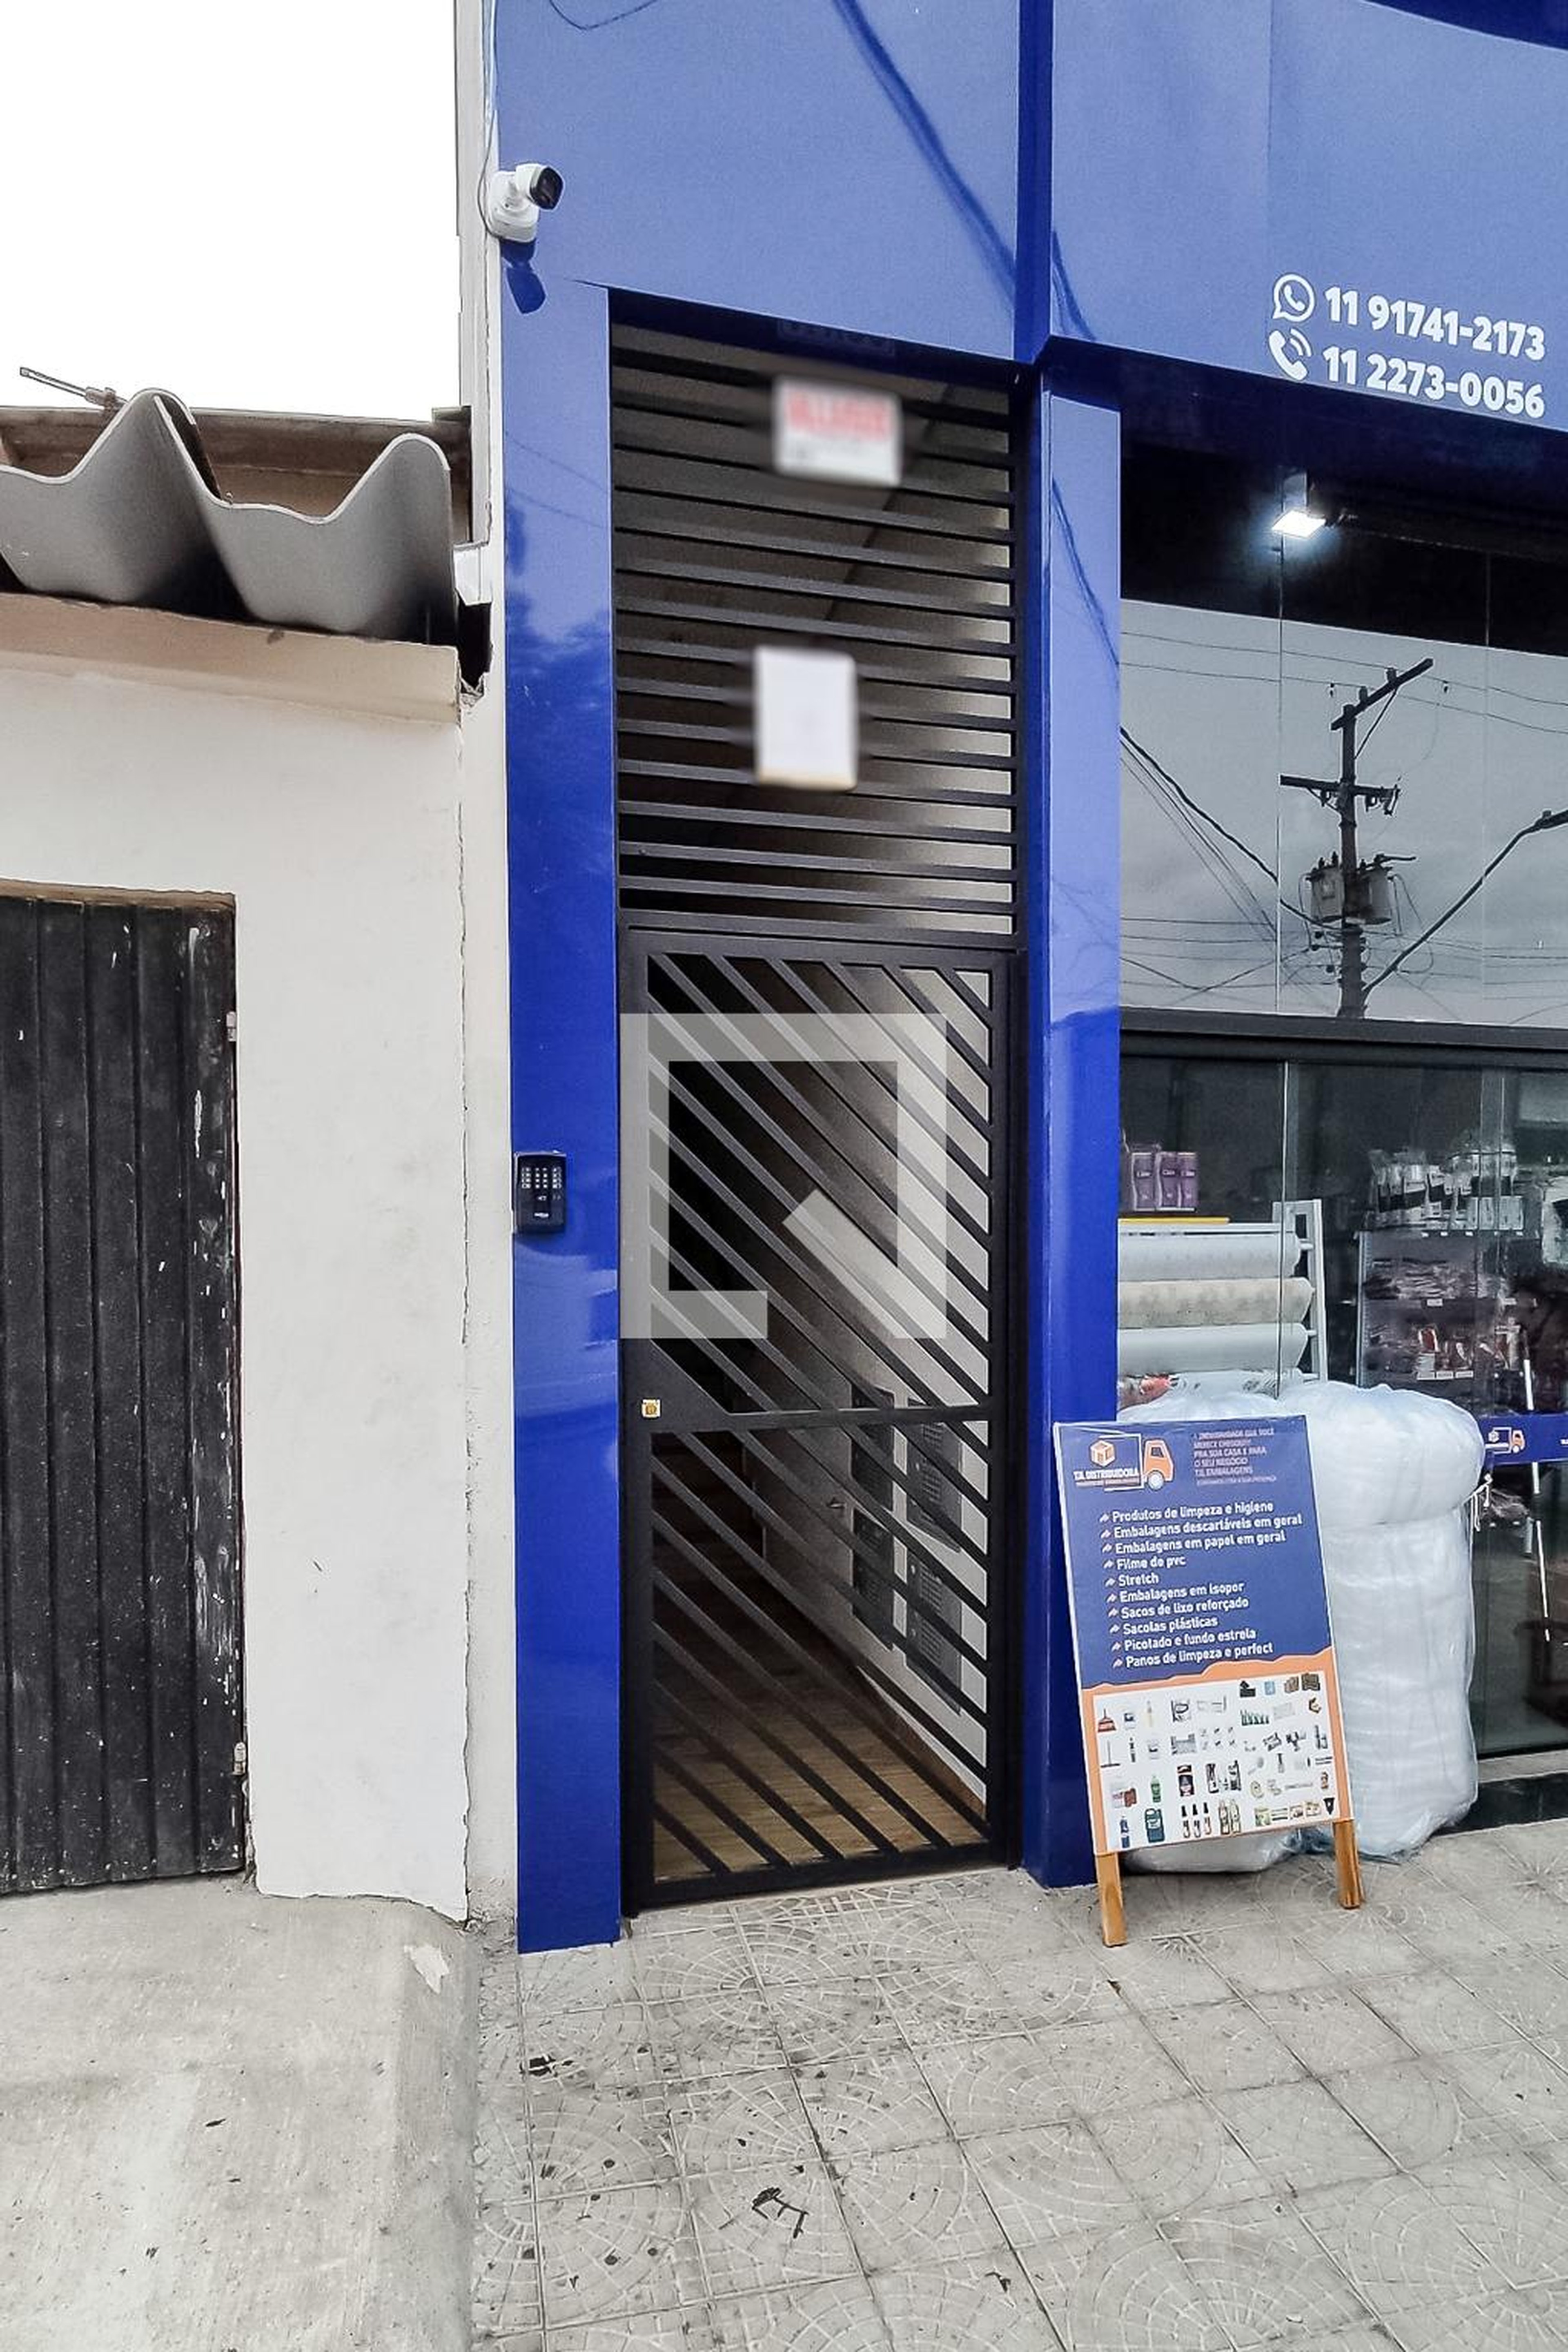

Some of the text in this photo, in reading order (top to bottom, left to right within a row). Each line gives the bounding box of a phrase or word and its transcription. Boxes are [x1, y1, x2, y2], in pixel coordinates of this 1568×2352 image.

[1324, 286, 1546, 361] 11 91741-2173
[1322, 345, 1546, 419] 11 2273-0056
[1112, 1501, 1274, 1522] Produtos de limpeza e higiene
[1114, 1512, 1302, 1538] Embalagens descartáveis em geral
[1116, 1530, 1286, 1554] Embalagens em papel em geral
[1116, 1555, 1186, 1570] Filme de pvc
[1118, 1572, 1159, 1586] Stretch
[1120, 1583, 1245, 1602] Embalagens em isopor
[1121, 1596, 1249, 1619] Sacos de lixo reforçado
[1123, 1617, 1218, 1635] Sacolas plásticas
[1124, 1628, 1257, 1651] Picotado e fundo estrela
[1126, 1642, 1273, 1668] Panos de limpeza e perfect
